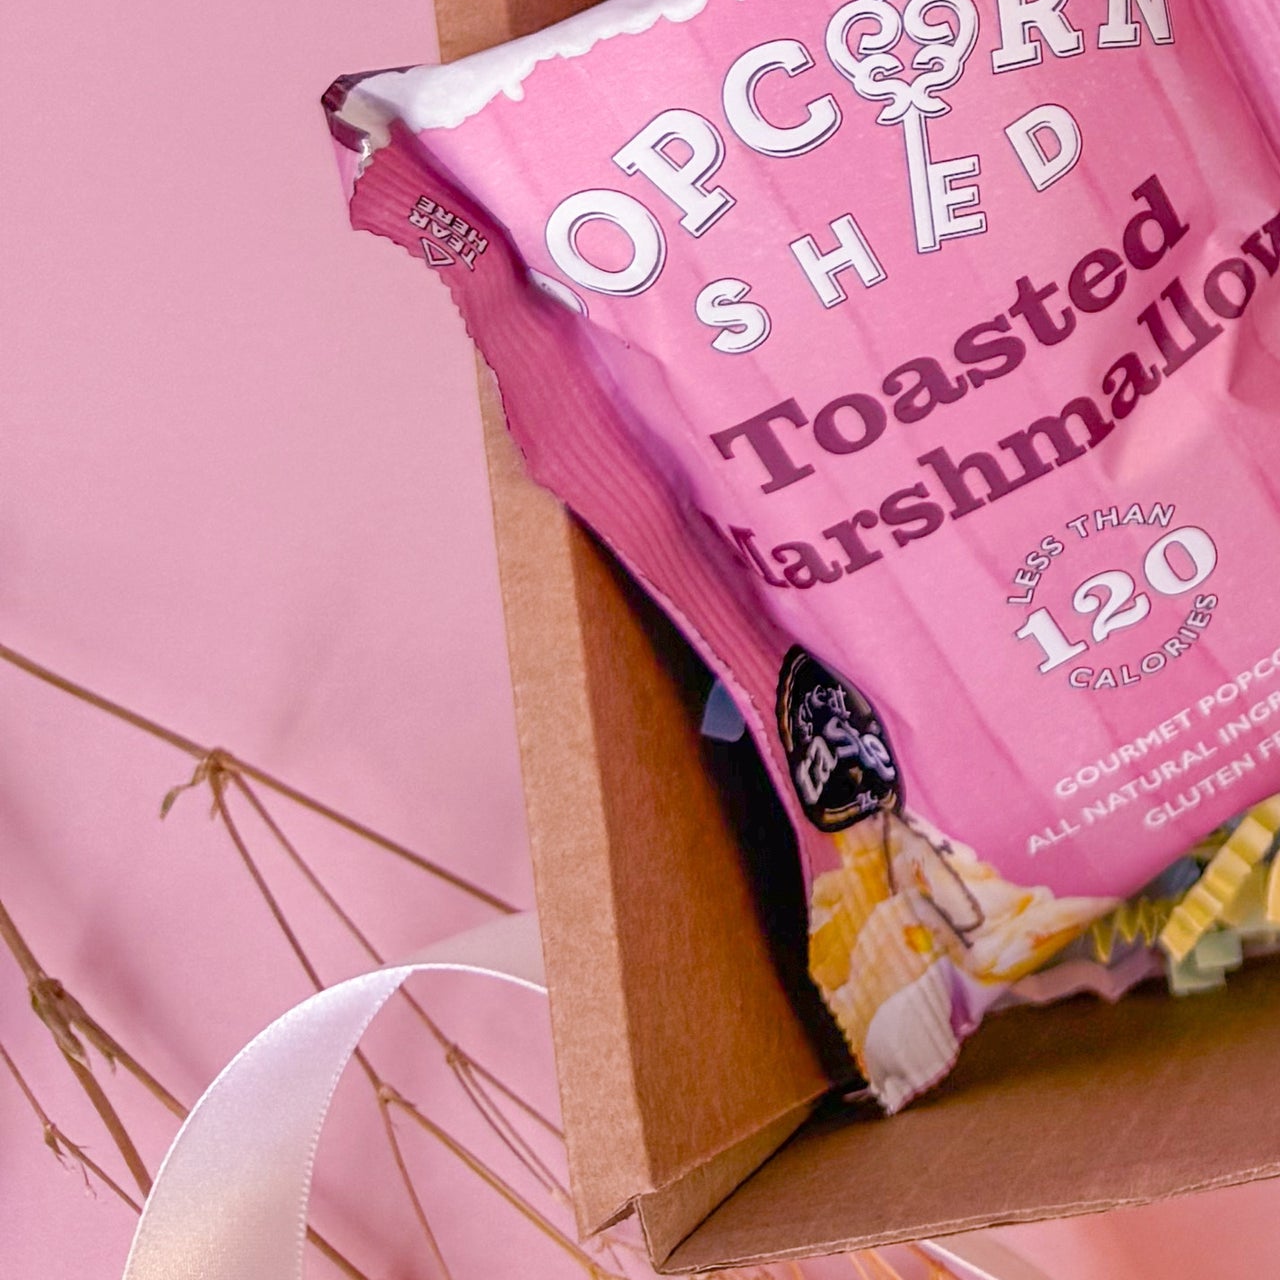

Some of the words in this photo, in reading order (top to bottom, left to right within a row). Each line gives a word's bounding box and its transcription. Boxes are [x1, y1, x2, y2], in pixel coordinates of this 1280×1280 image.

[408, 209, 475, 271] TEAR
[416, 195, 489, 254] HERE
[695, 102, 1083, 354] SHED
[710, 173, 1190, 495] Toasted
[1007, 535, 1064, 605] LESS
[1067, 502, 1176, 539] THAN
[1015, 524, 1219, 674] 120
[1069, 593, 1219, 689] CALORIES
[1027, 818, 1081, 855] ALL
[1083, 741, 1218, 824] NATURAL
[1054, 706, 1193, 799] GOURMET
[1144, 752, 1256, 829] GLUTEN
